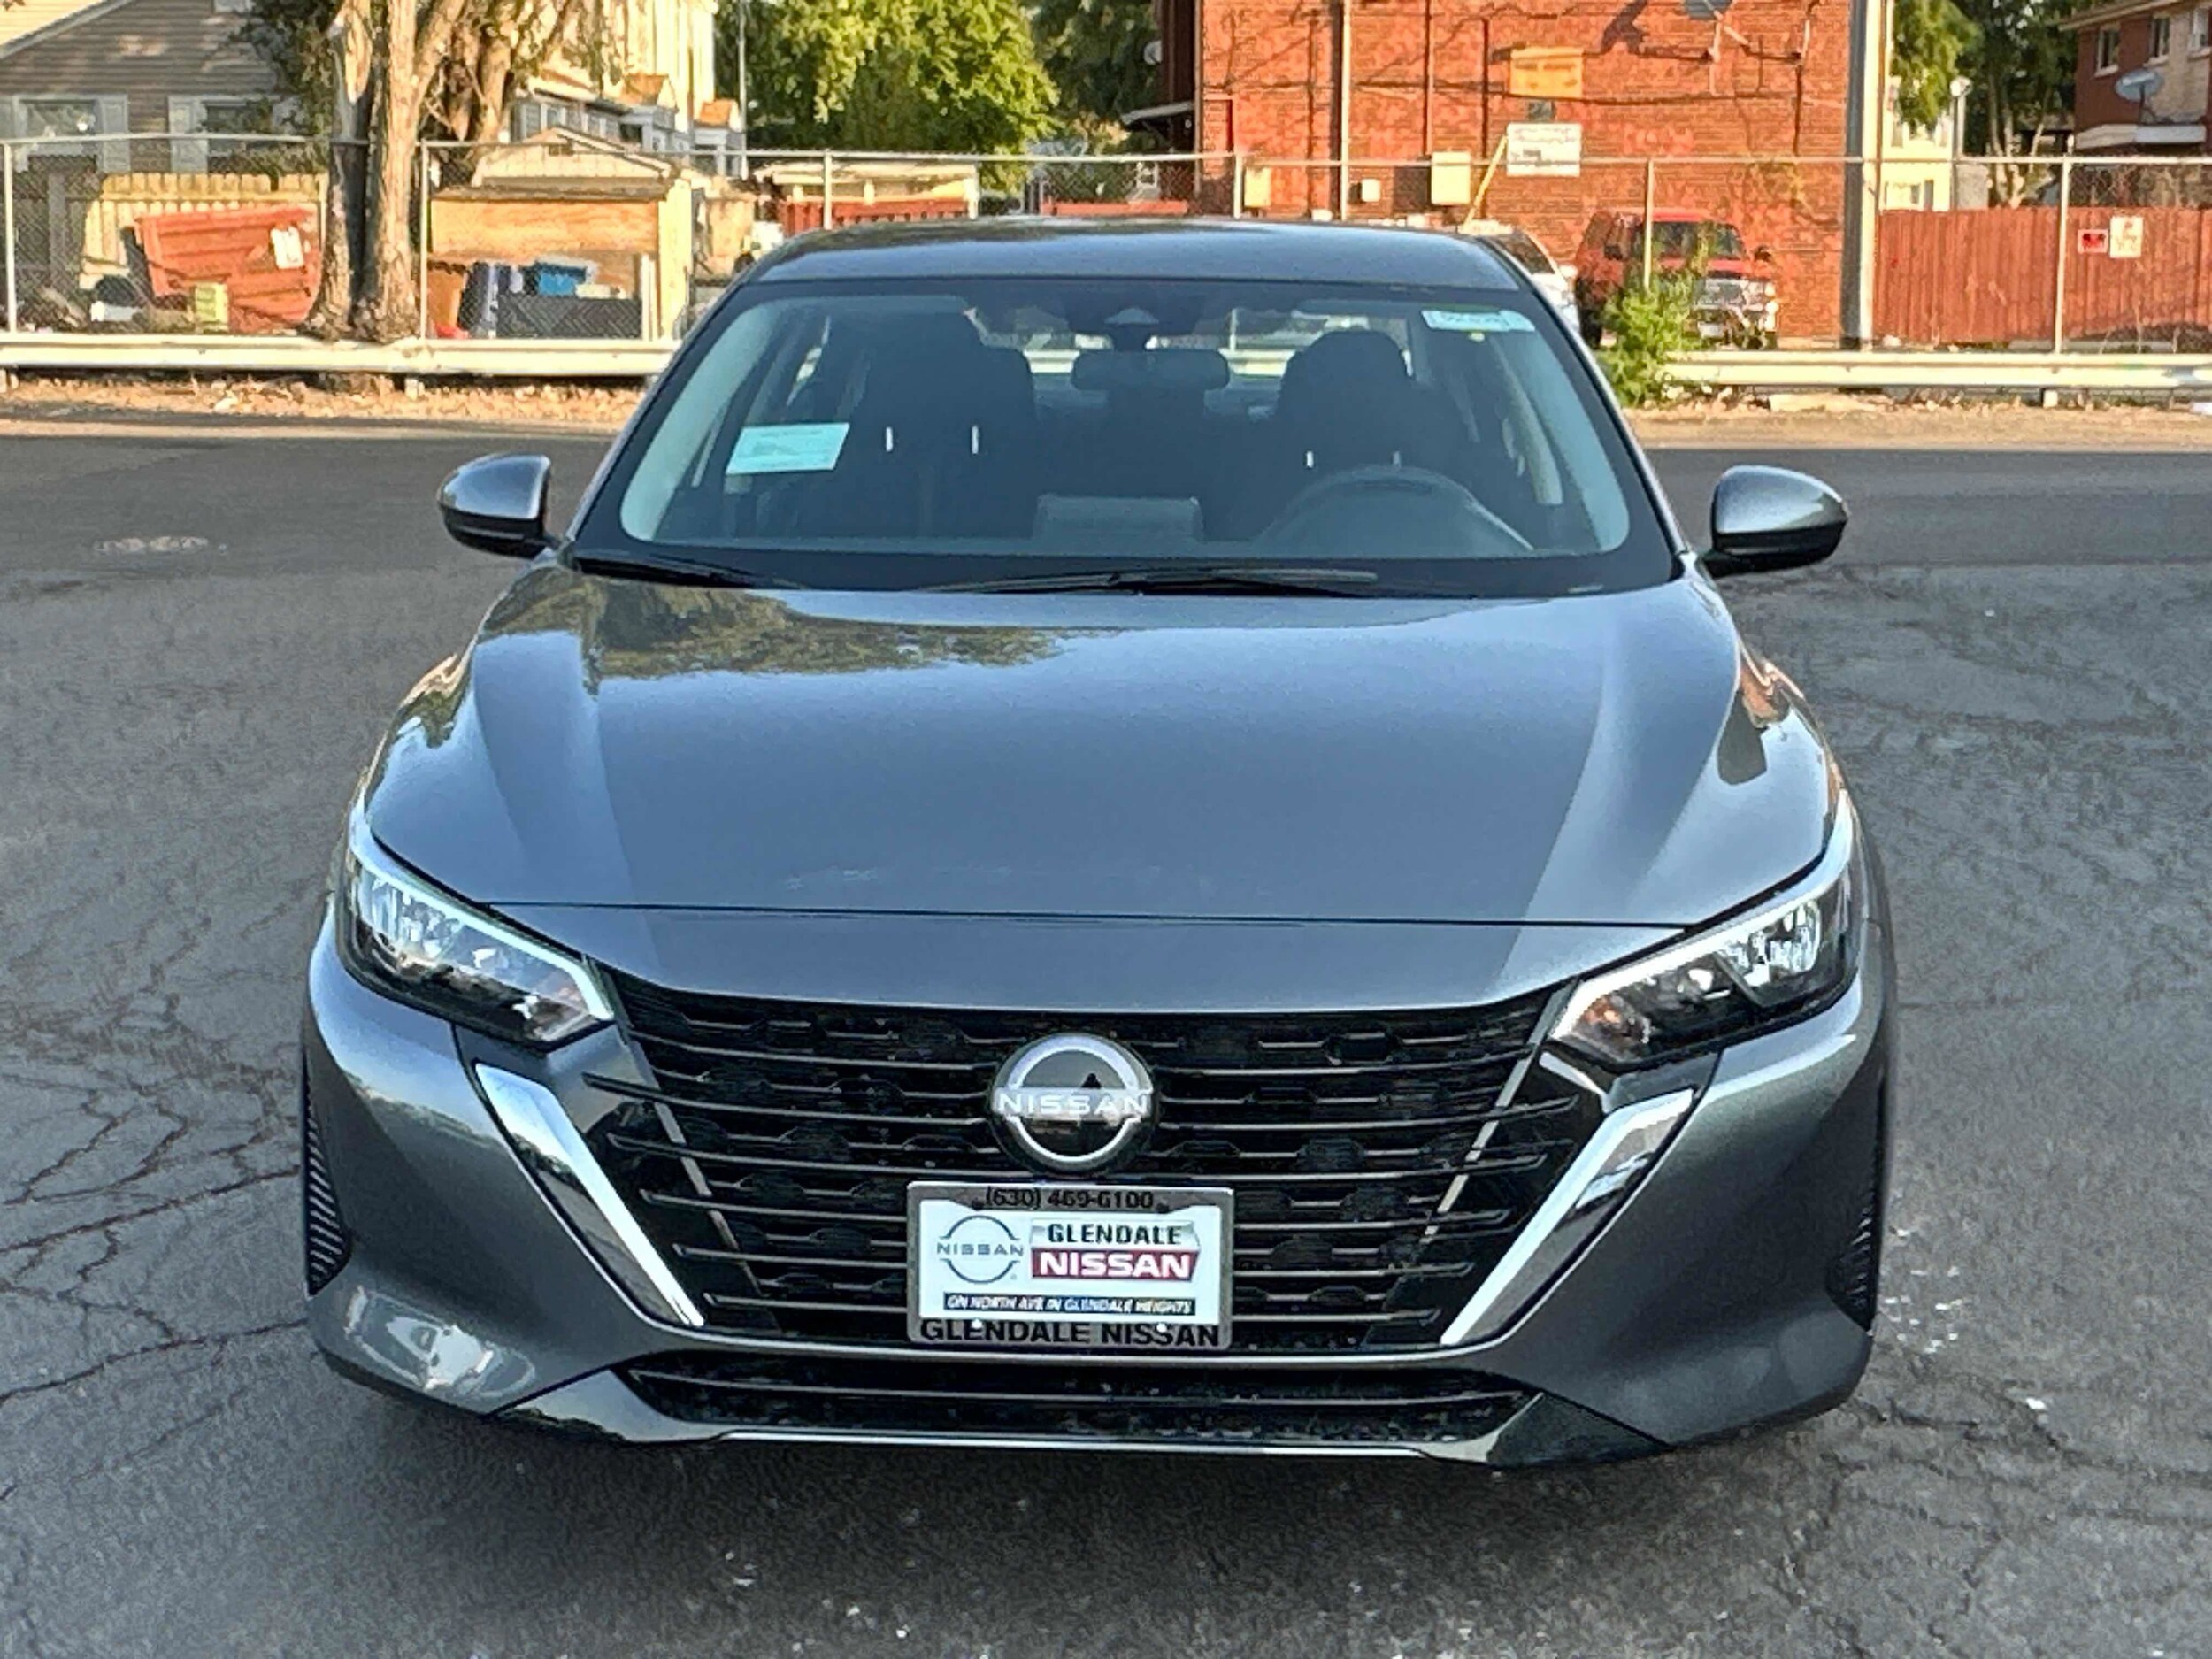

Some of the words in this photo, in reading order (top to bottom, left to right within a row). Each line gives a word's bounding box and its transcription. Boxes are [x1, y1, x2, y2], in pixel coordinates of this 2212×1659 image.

[997, 1094, 1148, 1115] NISSAN
[986, 1186, 1041, 1210] (630)
[1048, 1223, 1182, 1245] GLENDALE
[936, 1241, 1024, 1257] NISSAN
[1039, 1251, 1192, 1278] NISSAN
[920, 1318, 1091, 1344] GLENDALE
[1101, 1323, 1219, 1347] NISSAN
